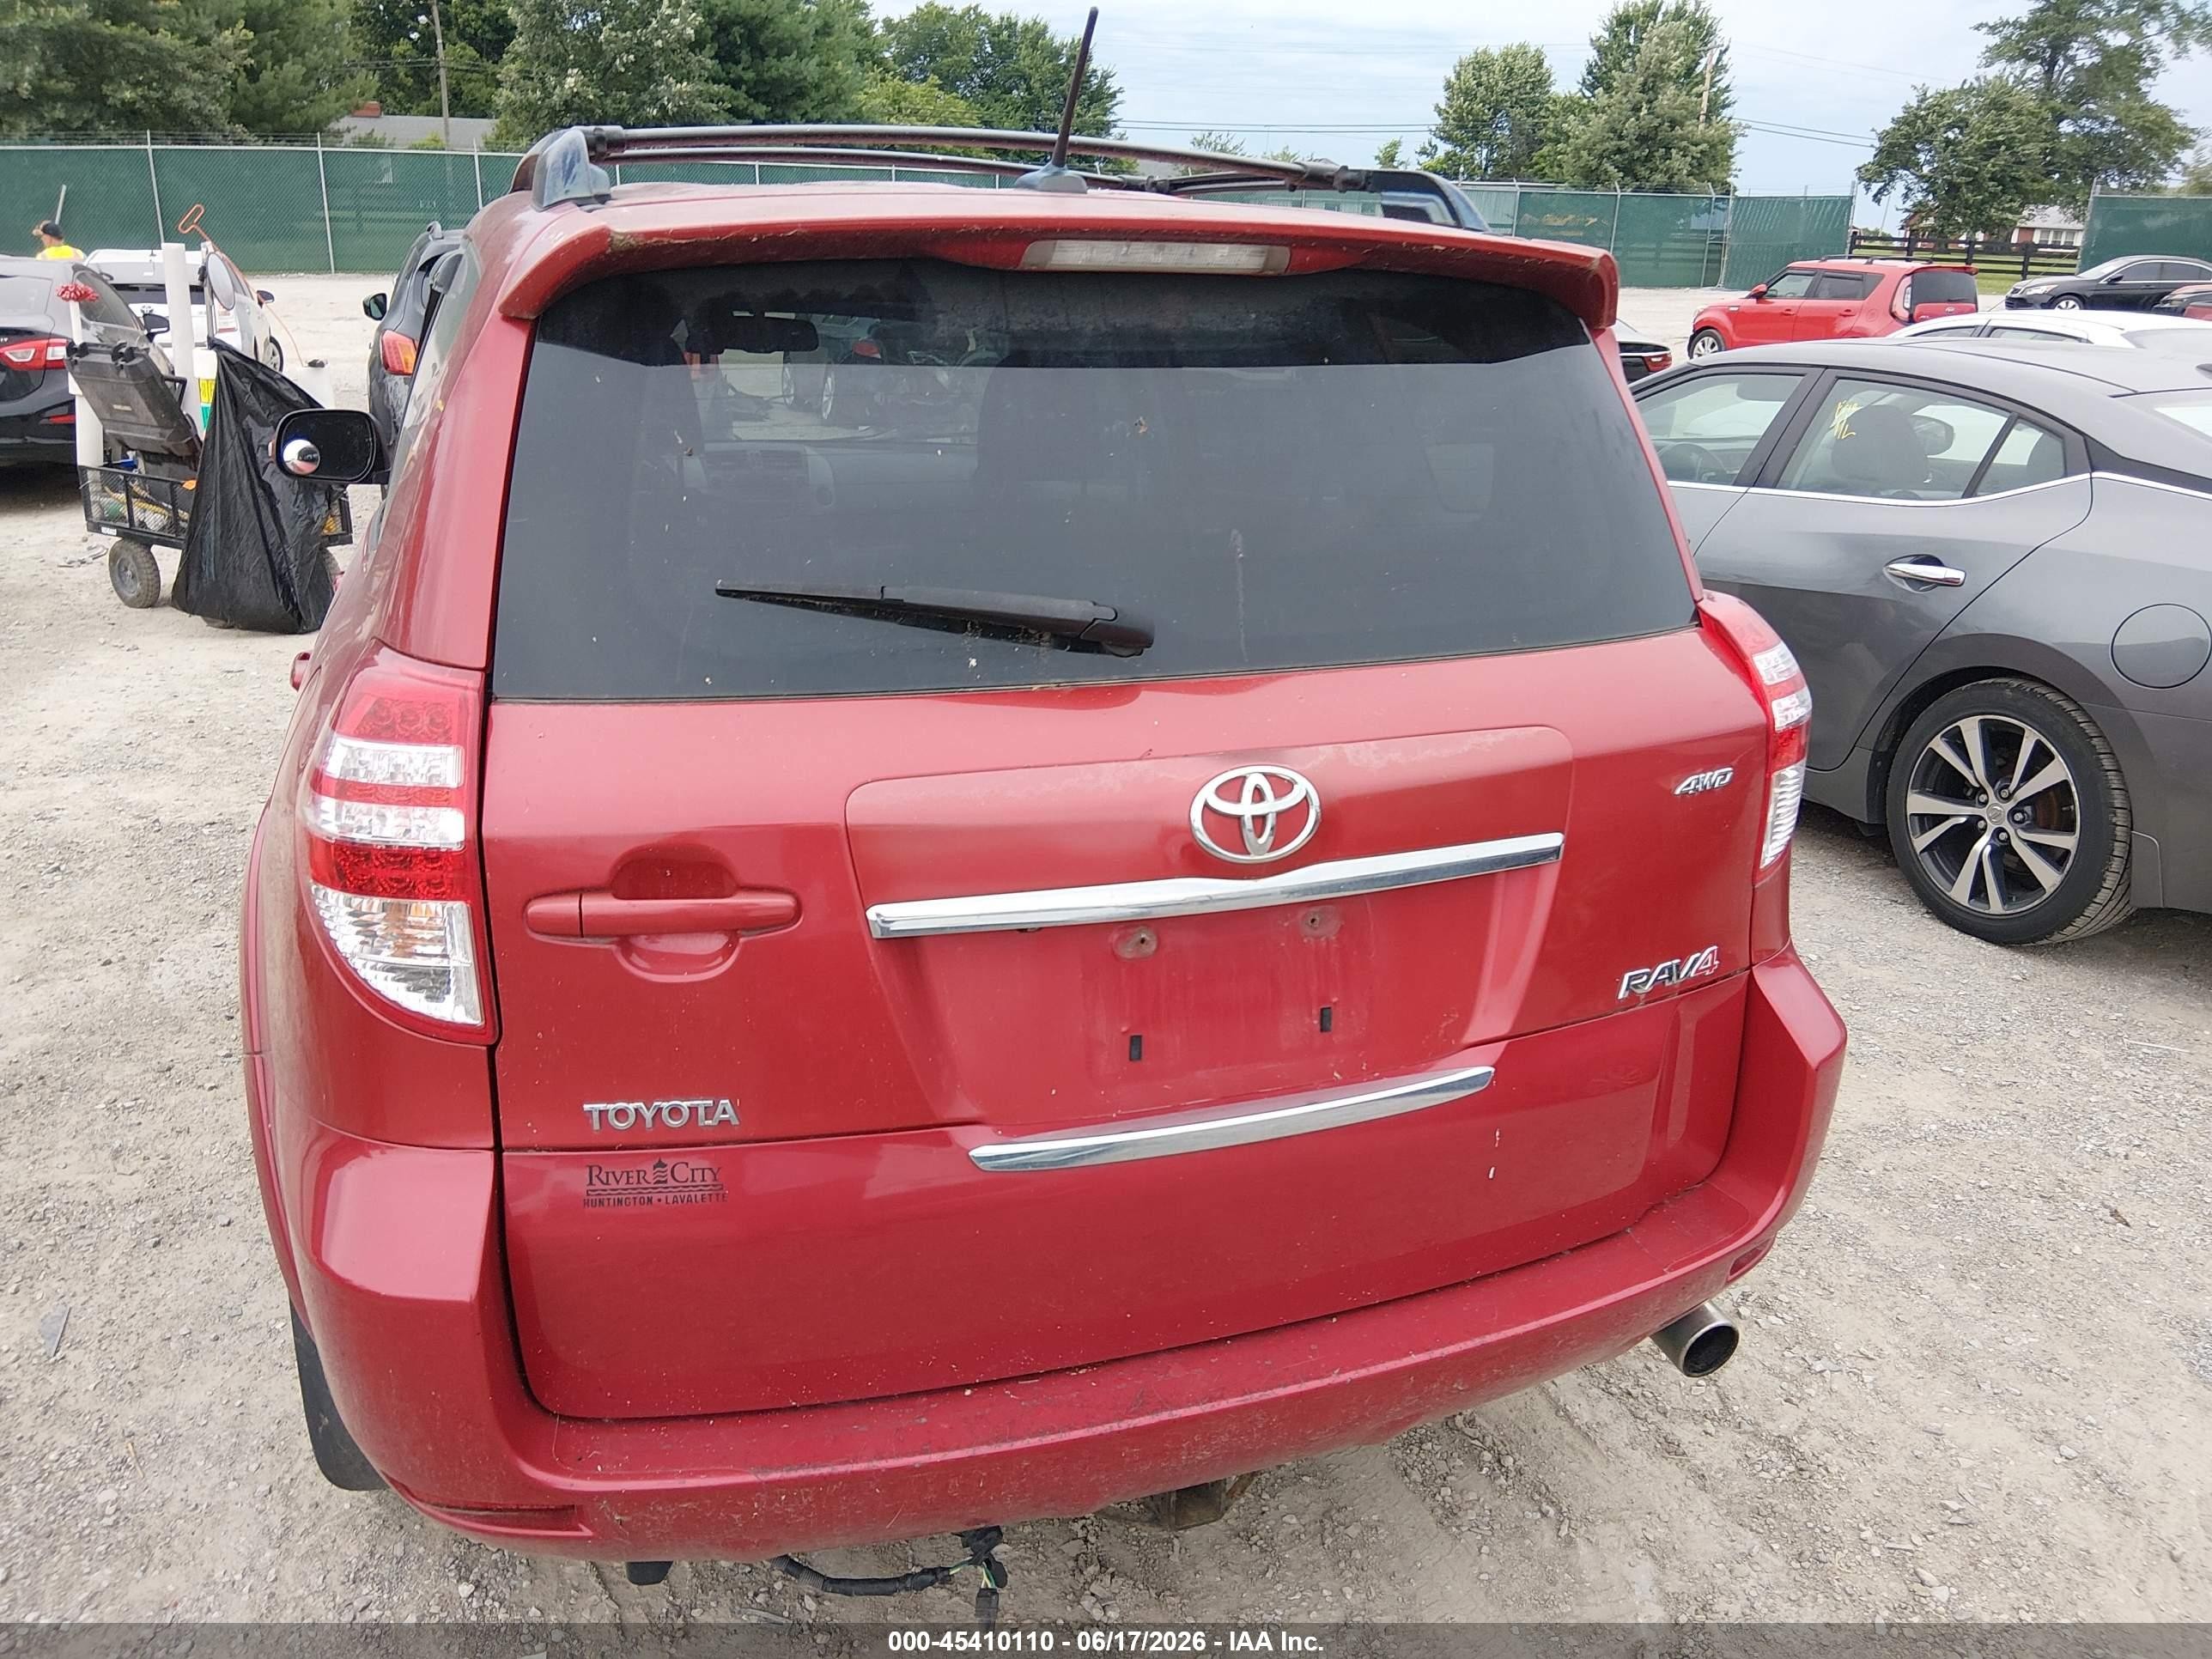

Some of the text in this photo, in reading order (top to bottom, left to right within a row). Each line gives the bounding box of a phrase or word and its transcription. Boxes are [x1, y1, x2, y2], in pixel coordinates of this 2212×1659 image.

[1673, 766, 1734, 796] 4WD
[1616, 945, 1720, 1000] RAV4
[582, 1098, 740, 1131] TOYOTA
[586, 1161, 722, 1187] RIVER CITY
[583, 1192, 729, 1208] HUNTINGTON LAVALETTE
